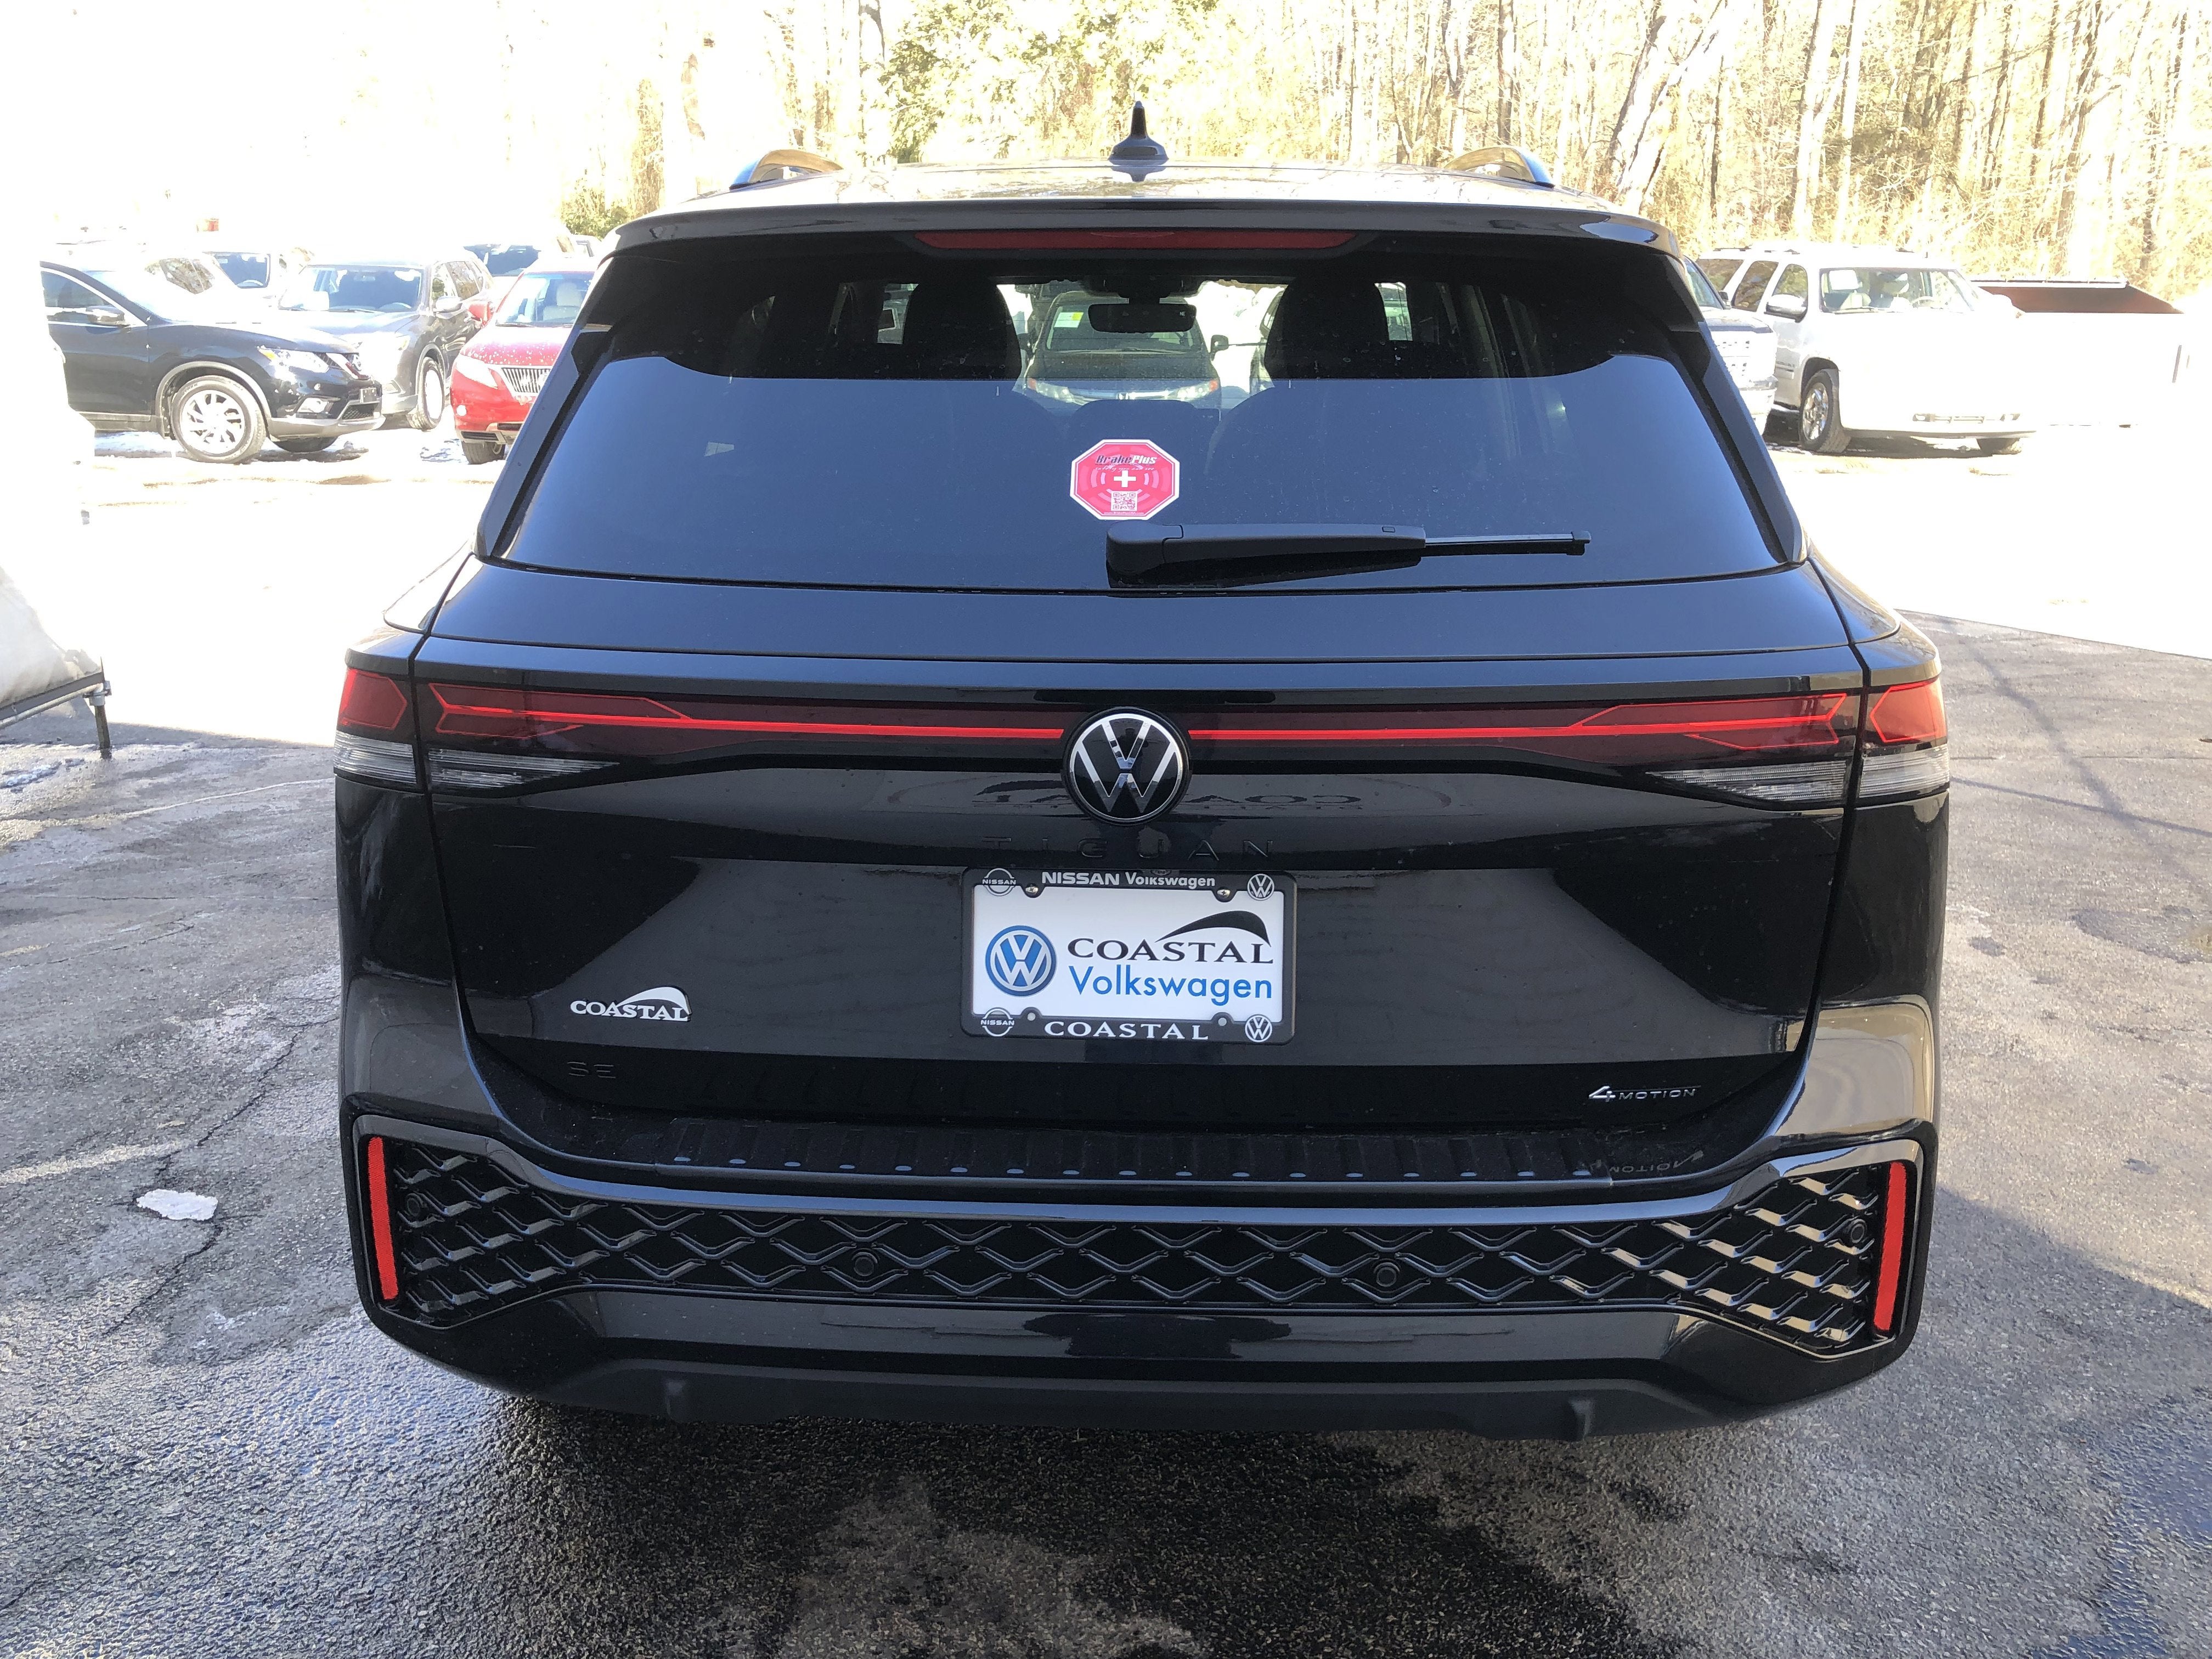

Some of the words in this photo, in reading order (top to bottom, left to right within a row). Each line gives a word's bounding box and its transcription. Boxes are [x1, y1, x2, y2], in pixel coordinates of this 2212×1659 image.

[1096, 455, 1157, 464] BrakePlus
[982, 837, 1273, 861] TIGUAN
[1042, 871, 1120, 886] NISSAN
[1125, 872, 1216, 889] Volkswagen
[1067, 938, 1274, 964] COASTAL
[1068, 964, 1272, 1006] Volkswagen
[570, 1000, 689, 1022] COASTAL
[980, 1018, 1015, 1027] NISSAN
[1044, 1020, 1209, 1040] COASTAL
[567, 1060, 616, 1079] SE
[1588, 1086, 1696, 1102] 4MOTION
